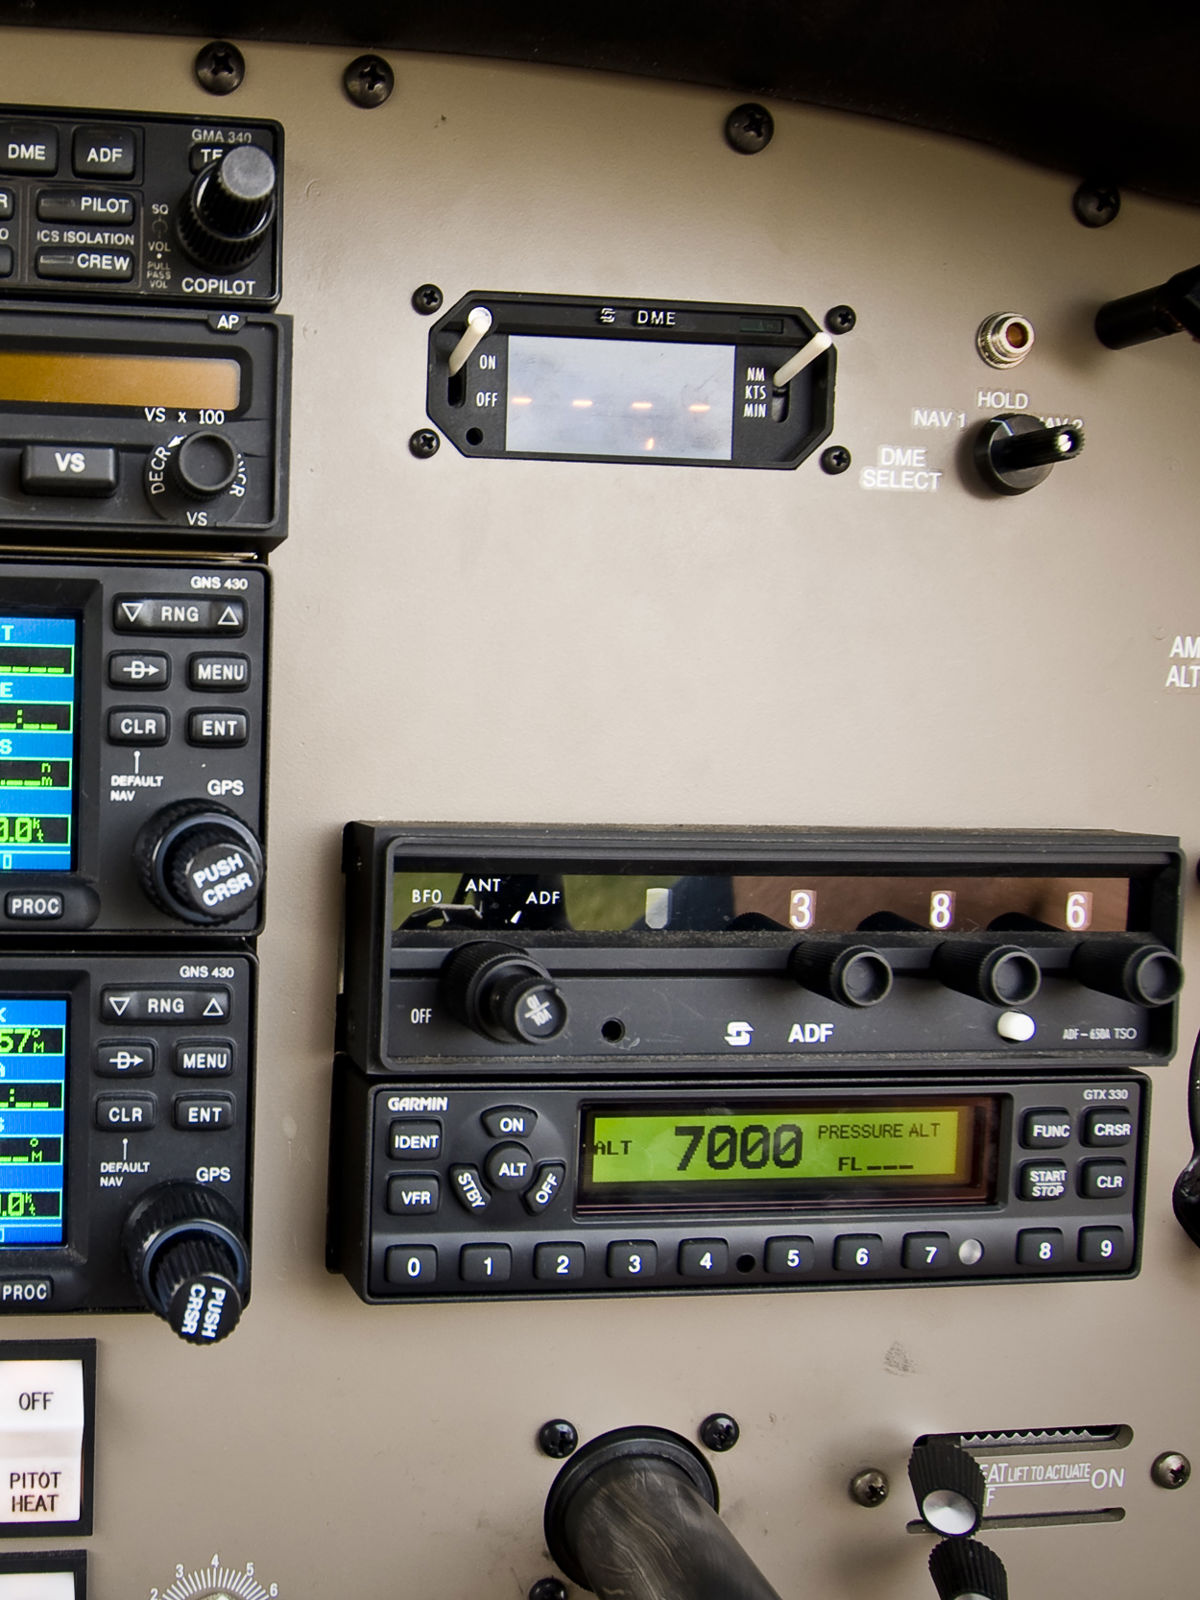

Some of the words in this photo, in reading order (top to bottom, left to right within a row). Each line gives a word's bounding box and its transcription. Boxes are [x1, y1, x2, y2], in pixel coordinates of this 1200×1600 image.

[192, 129, 224, 142] GMA
[227, 132, 252, 144] 340
[8, 144, 45, 160] DME
[87, 148, 122, 162] ADF
[81, 197, 129, 214] PILOT
[37, 230, 59, 243] ICS
[63, 232, 135, 246] ISOLATION
[77, 254, 130, 271] CREW
[182, 277, 256, 295] COPILOT
[216, 313, 239, 330] AP
[637, 311, 676, 326] DME
[476, 392, 498, 408] OFF
[745, 385, 766, 401] KTS
[977, 391, 1029, 410] HOLD
[144, 407, 166, 422] VS
[199, 409, 225, 425] 100
[914, 410, 952, 428] NAV
[958, 413, 966, 428] 1
[55, 453, 86, 472] VS
[881, 448, 927, 468] DME
[149, 446, 171, 495] DECR
[863, 470, 942, 490] SELECT
[186, 511, 208, 526] VS
[191, 576, 221, 589] GNS
[224, 578, 248, 590] 430
[161, 607, 199, 621] RNG
[198, 664, 244, 680] MENU
[121, 719, 156, 734] CLR
[202, 721, 237, 736] ENT
[111, 775, 163, 787] DEFAULT
[207, 780, 244, 795] GPS
[193, 853, 244, 888] PUSH
[203, 872, 253, 906] CRSR
[465, 878, 501, 892] ANT
[411, 889, 442, 904] BFO
[526, 892, 561, 905] ADF
[12, 898, 59, 914] PROC
[790, 892, 813, 929] 3
[931, 893, 951, 929] 8
[1066, 894, 1086, 929] 6
[179, 966, 209, 978] GNS
[211, 967, 235, 978] 430
[147, 998, 185, 1013] RNG
[410, 1009, 432, 1024] OFF
[788, 1023, 834, 1044] ADF
[1114, 1028, 1137, 1040] TSO
[183, 1053, 227, 1069] MENU
[1084, 1089, 1108, 1100] GTX
[1110, 1089, 1128, 1100] 330
[388, 1097, 448, 1112] GARMIN
[108, 1107, 143, 1122] CLR
[188, 1107, 222, 1123] ENT
[500, 1118, 523, 1132] ON
[818, 1123, 903, 1140] PRESSURE
[909, 1122, 940, 1138] ALT
[1033, 1125, 1070, 1138] FUNC
[1094, 1123, 1131, 1136] CRSR
[395, 1135, 439, 1149] IDENT
[594, 1140, 632, 1156] ALT
[674, 1124, 803, 1171] 7000
[100, 1162, 150, 1173] DEFAULT
[196, 1167, 231, 1182] GPS
[499, 1163, 526, 1177] ALT
[1030, 1170, 1067, 1183] START
[1097, 1175, 1122, 1189] CLR
[402, 1191, 431, 1205] VFR
[458, 1172, 485, 1210] STBY
[1032, 1184, 1064, 1197] STOP
[2, 1283, 48, 1300] PROC
[19, 1392, 54, 1411] OFF
[10, 1471, 62, 1489] PITOT
[1008, 1466, 1029, 1482] LIFT
[1031, 1465, 1044, 1481] TO
[1045, 1463, 1091, 1480] ACTUATE
[12, 1494, 59, 1513] HEAT
